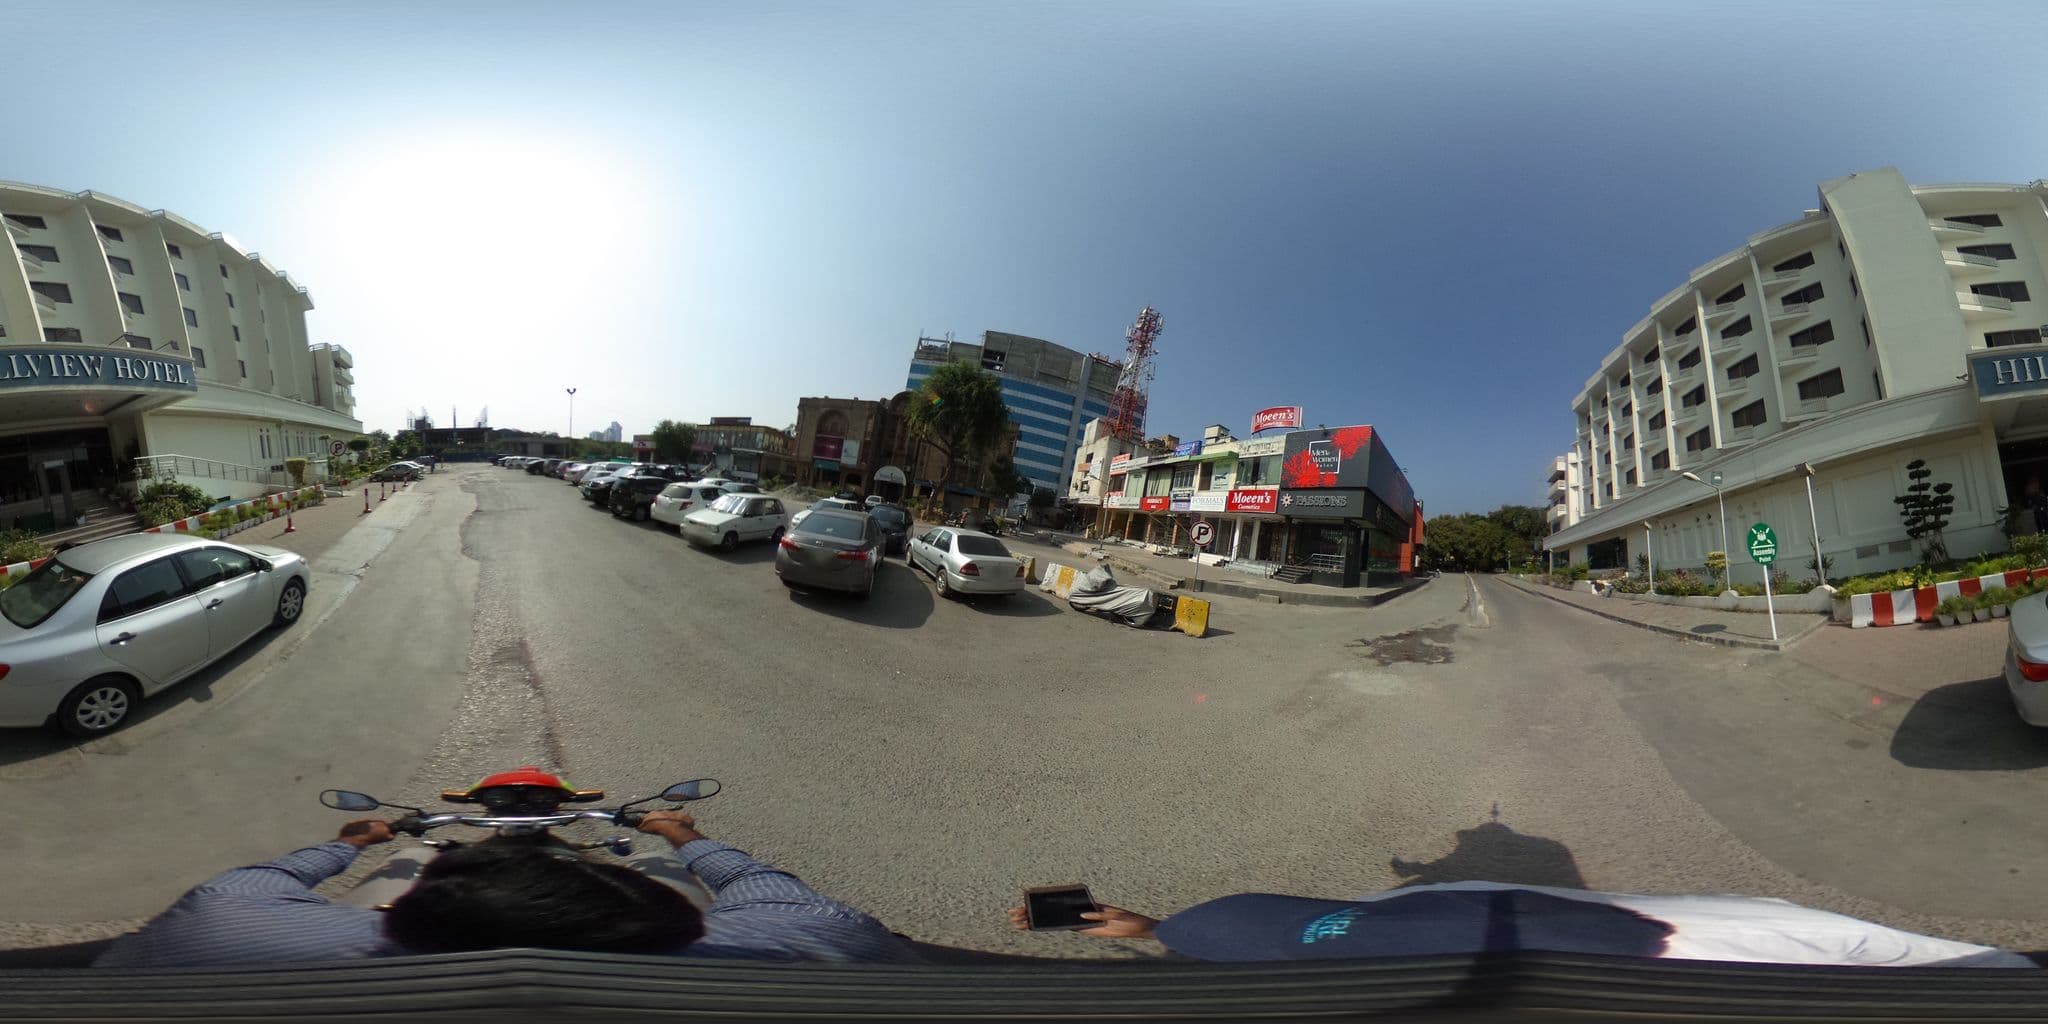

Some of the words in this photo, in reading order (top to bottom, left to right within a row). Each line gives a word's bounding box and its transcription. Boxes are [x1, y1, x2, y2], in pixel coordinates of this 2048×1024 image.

[112, 357, 189, 384] HOTEL
[1256, 409, 1293, 424] Moeen's
[1232, 492, 1271, 504] Moeen's
[1753, 548, 1775, 556] Assembly
